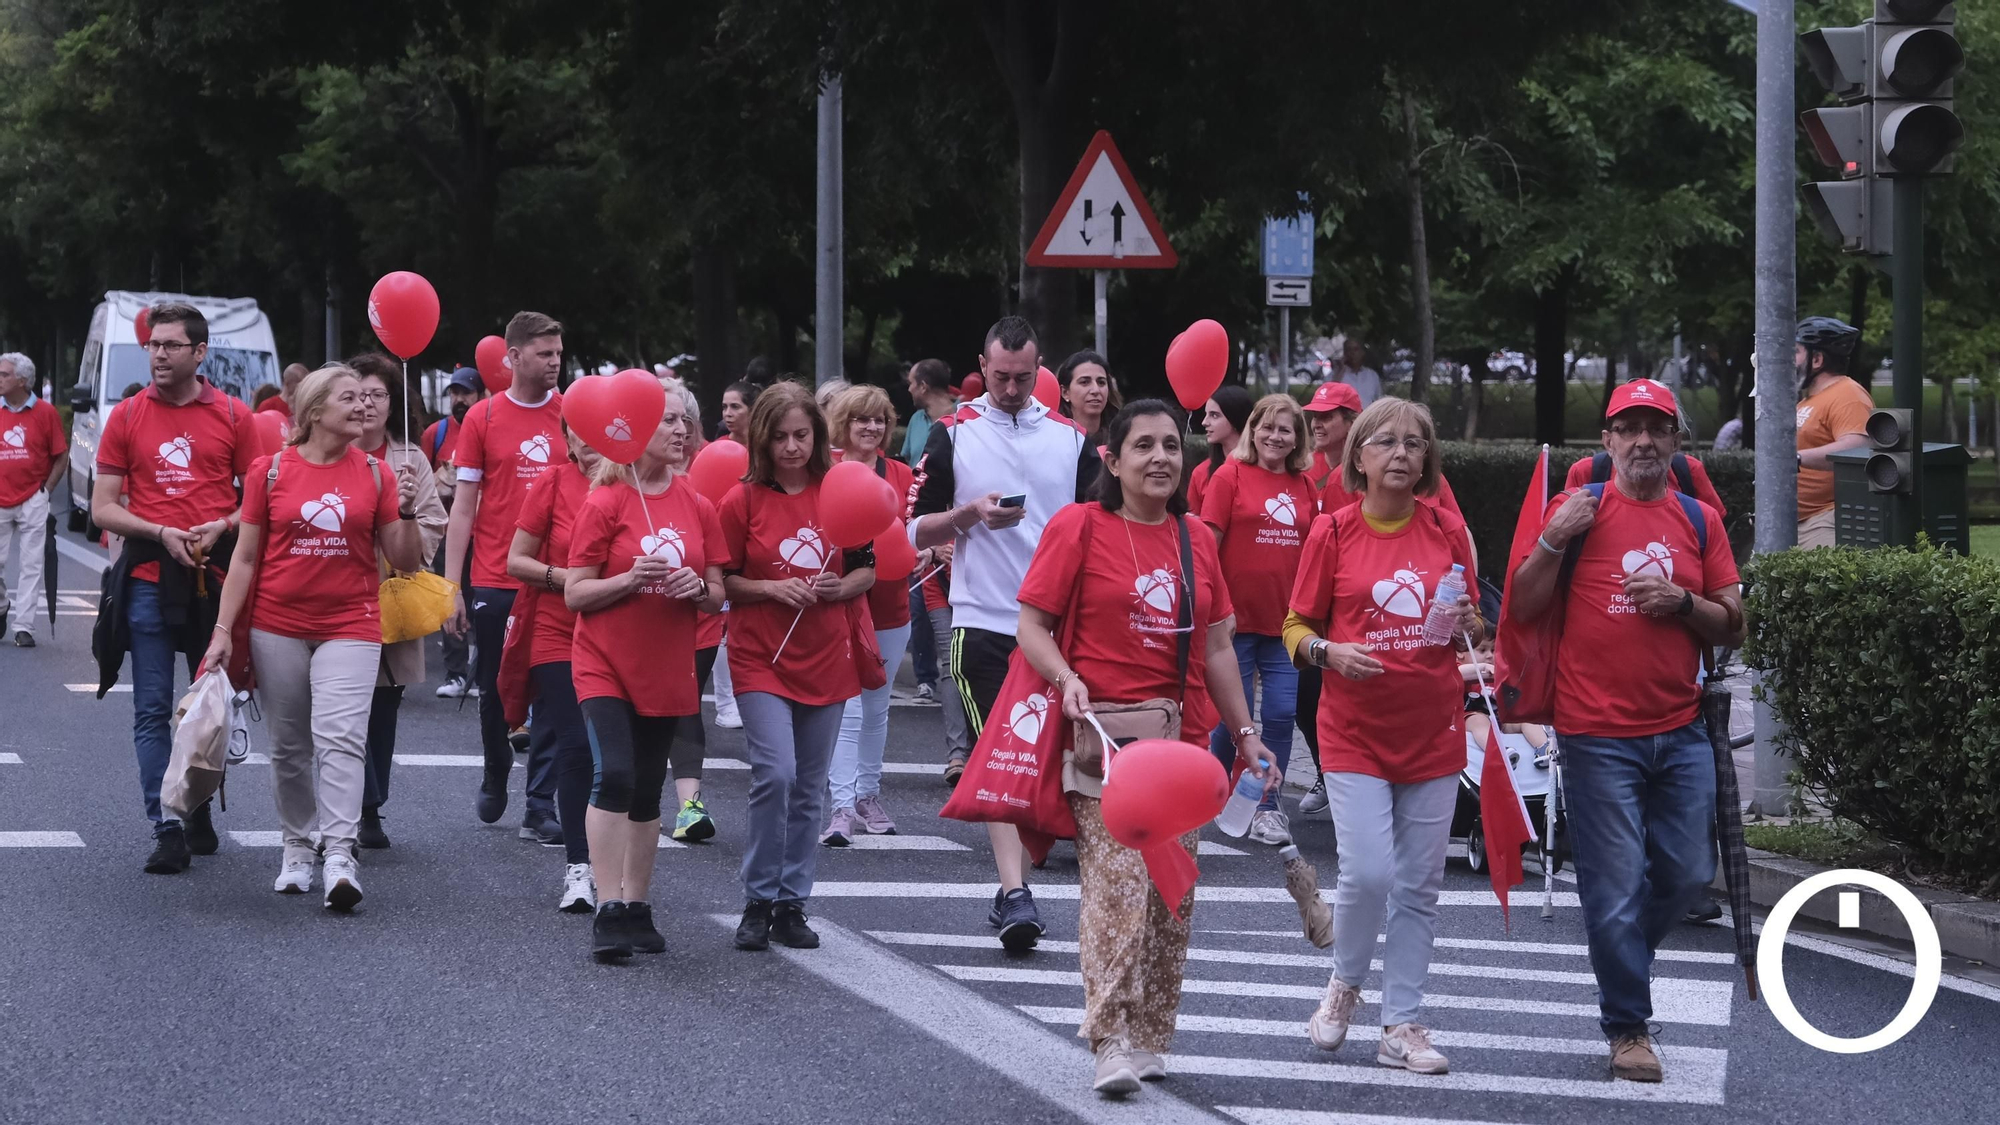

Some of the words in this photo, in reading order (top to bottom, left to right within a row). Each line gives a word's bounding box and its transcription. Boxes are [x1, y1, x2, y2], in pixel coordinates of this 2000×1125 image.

[1258, 528, 1280, 537] regala
[1281, 529, 1299, 537] VIDA
[293, 537, 321, 547] regala
[323, 537, 347, 546] VIDA
[1255, 536, 1274, 544] dona
[1274, 537, 1300, 546] órganos
[289, 546, 311, 555] dona
[313, 546, 349, 558] órganos
[1607, 604, 1637, 614] dona
[1129, 612, 1156, 624] Regala
[1365, 627, 1400, 641] regala
[1402, 624, 1424, 636] VID
[990, 748, 1016, 761] Regala
[986, 760, 1006, 771] dona
[1006, 761, 1039, 777] órganos
